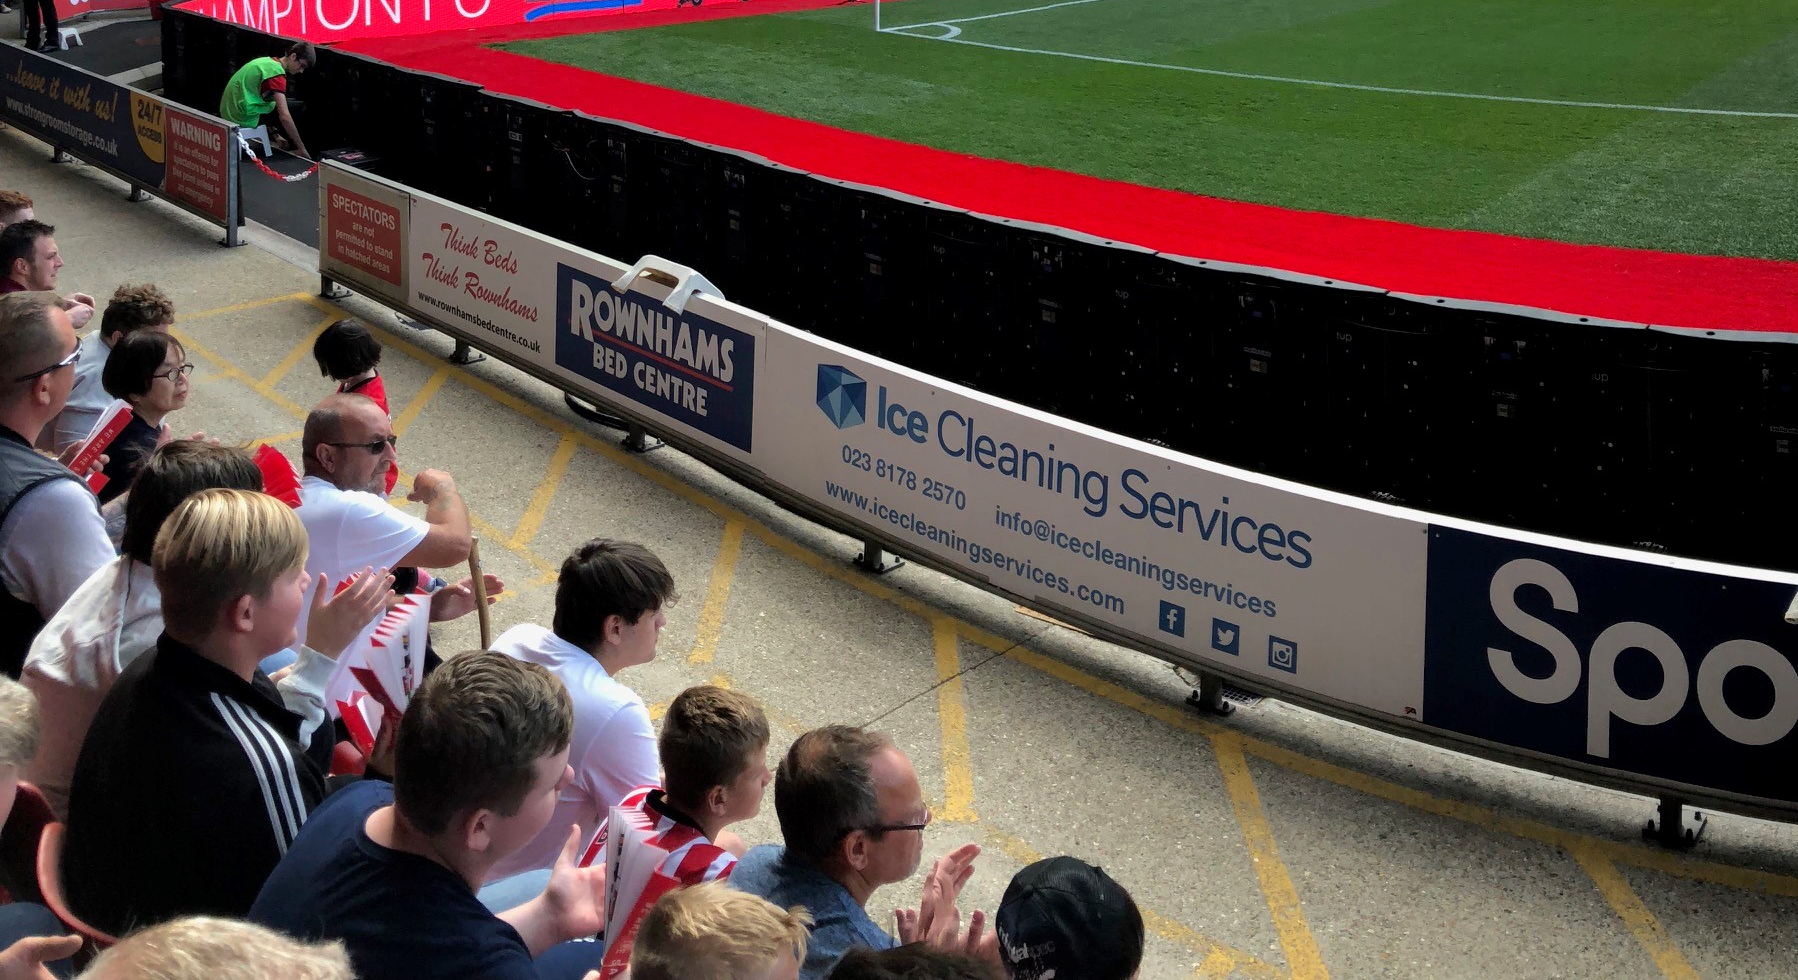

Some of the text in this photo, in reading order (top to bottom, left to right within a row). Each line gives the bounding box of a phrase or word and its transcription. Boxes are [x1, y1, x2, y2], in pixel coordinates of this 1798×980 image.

[49, 76, 60, 101] it
[63, 82, 92, 113] with
[137, 98, 162, 126] 24/7
[6, 96, 119, 158] www.strongroomstorage.co.uk
[170, 116, 222, 152] WARNING
[332, 192, 395, 232] SPECTATORS
[352, 222, 375, 239] are not
[336, 230, 394, 260] permitted to stand
[338, 244, 391, 274] in hatched areas
[440, 222, 518, 275] Think Beds
[422, 252, 538, 323] Think Rownhams
[418, 291, 541, 354] www.rownhamsbedcentre.co.uk
[570, 278, 734, 383] ROWNHAMS
[592, 342, 708, 418] BED CENTRE
[92, 438, 105, 452] ARE
[842, 444, 966, 511] 023 8178 2570
[877, 384, 1312, 569] Ice Cleaning Services
[825, 479, 1125, 615] www.icecleaningservices.com
[995, 505, 1277, 618] info@icecleaningservices
